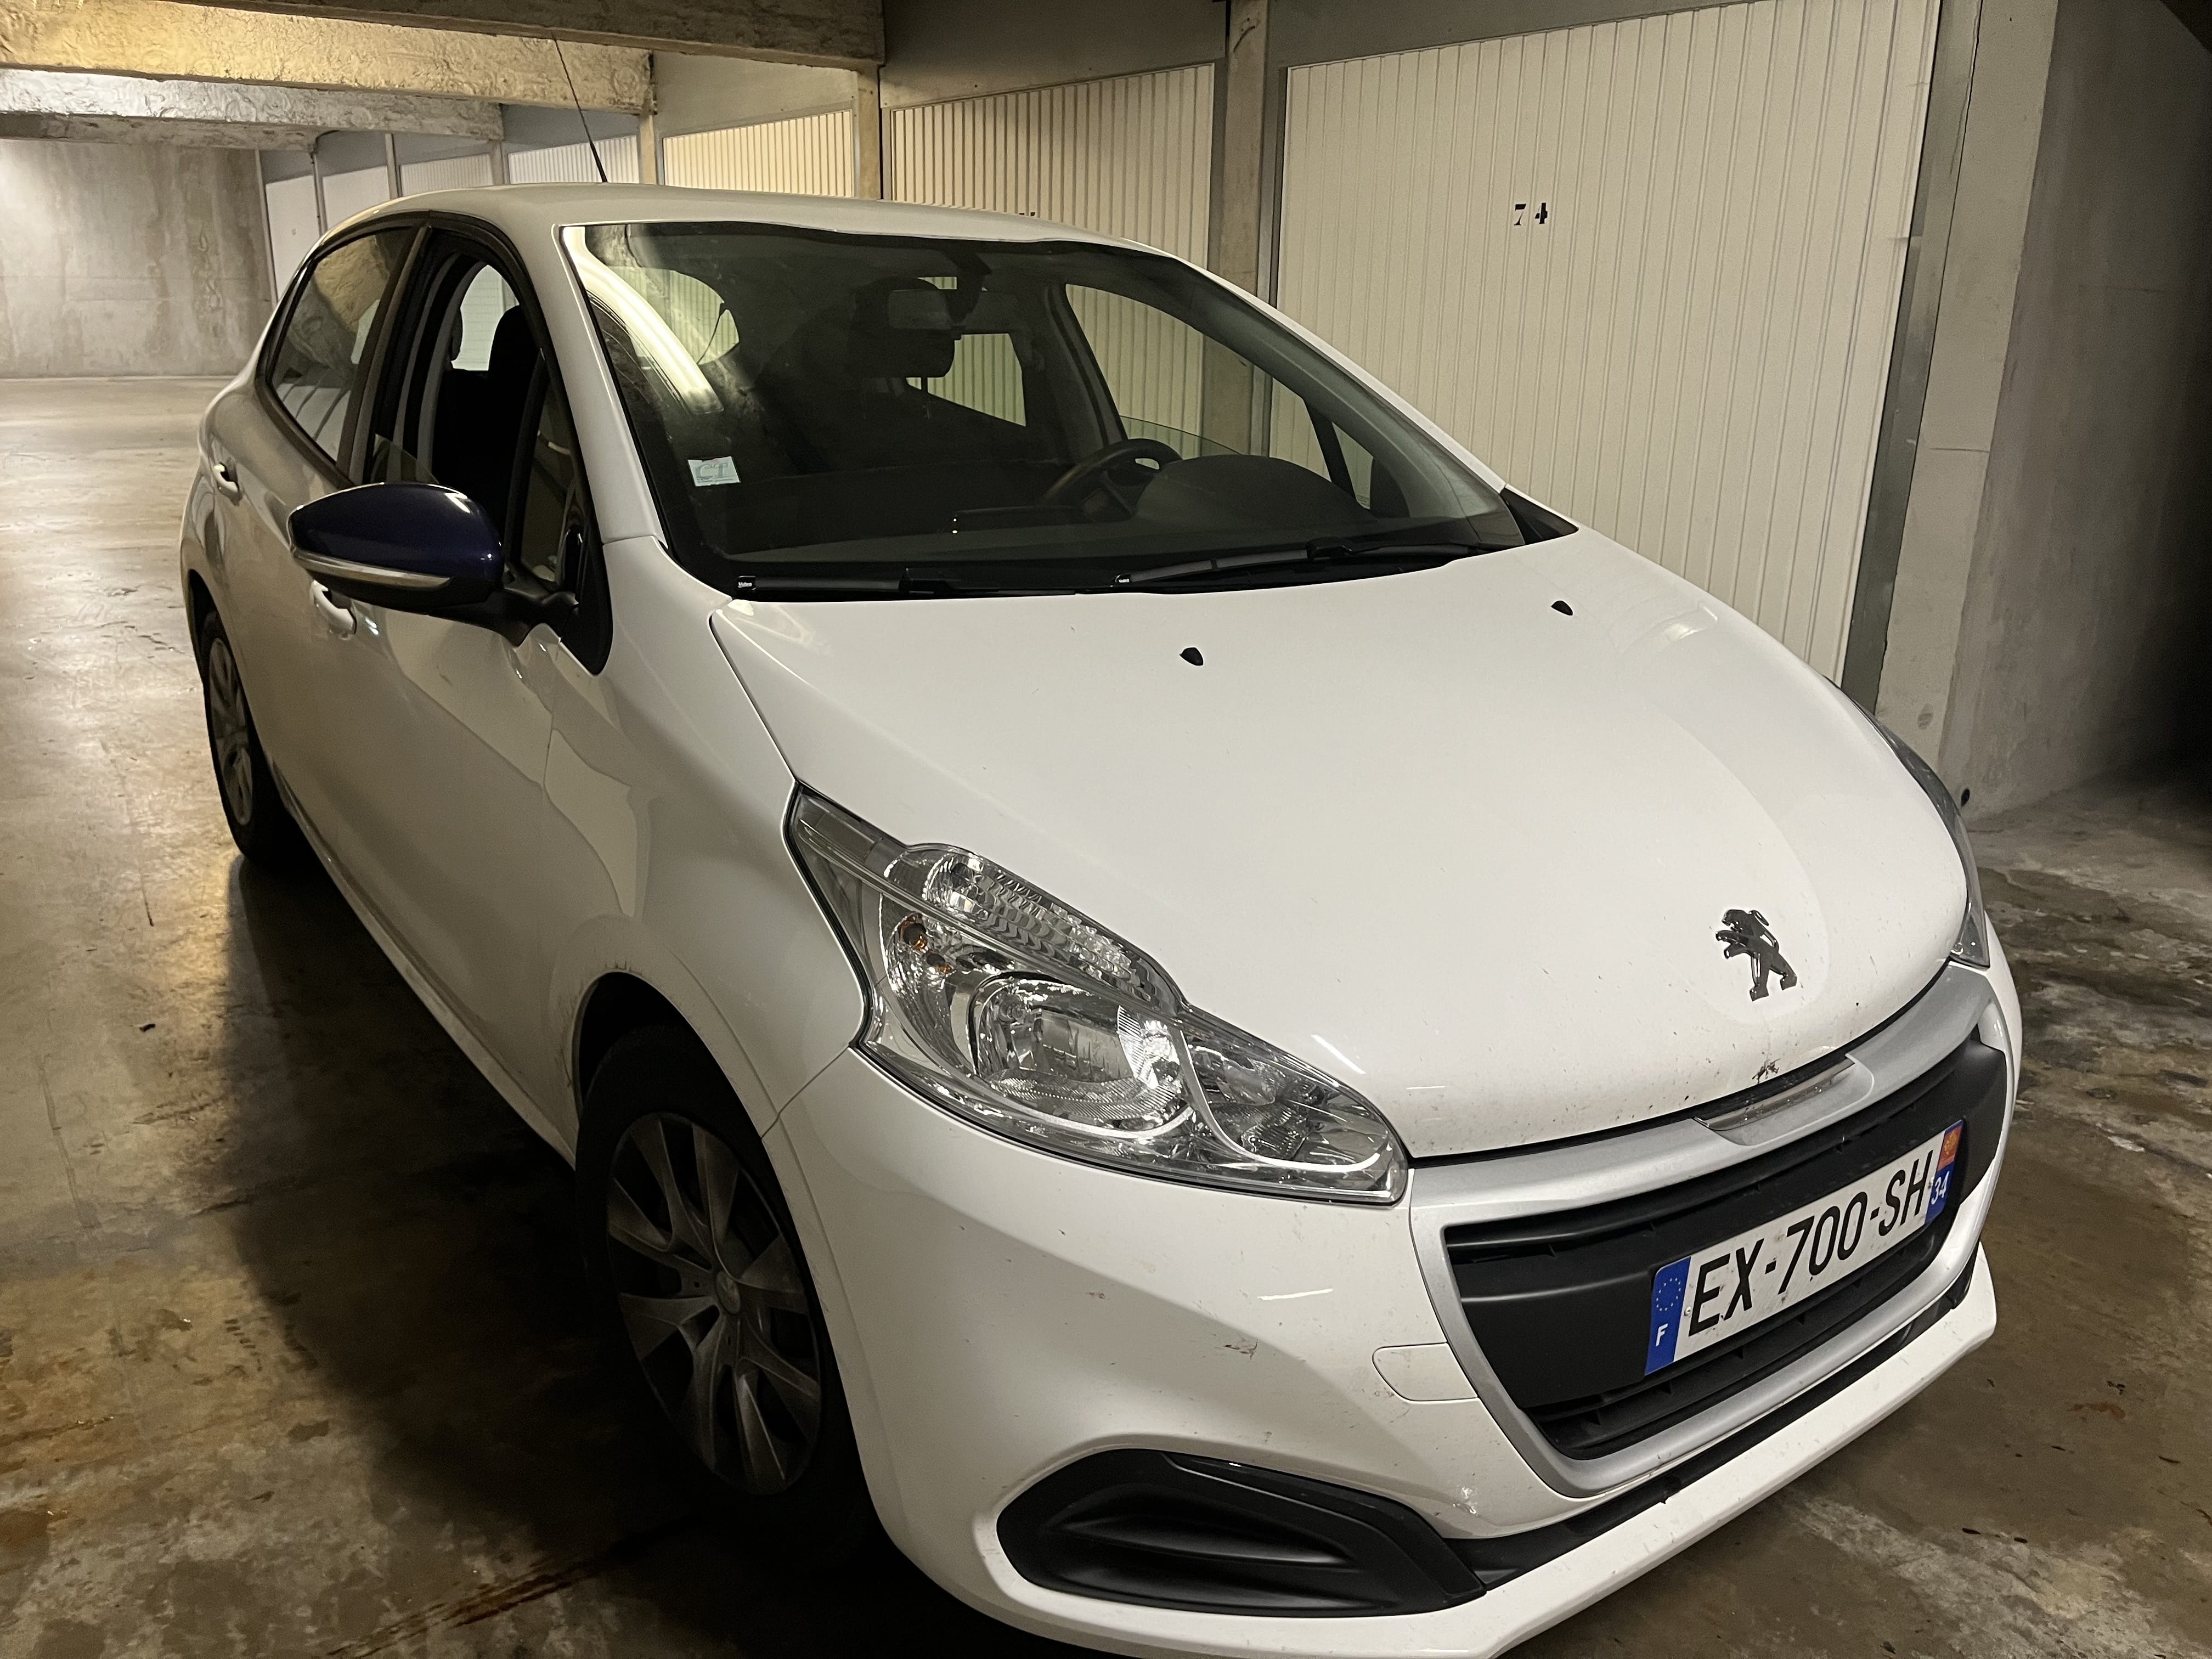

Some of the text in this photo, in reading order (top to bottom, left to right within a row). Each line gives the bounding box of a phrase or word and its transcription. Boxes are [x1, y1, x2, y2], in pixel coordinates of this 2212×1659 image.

[1514, 202, 1548, 225] 74
[1931, 1171, 1950, 1205] 34
[1688, 1150, 1933, 1337] EX-700-SH
[1655, 1323, 1668, 1347] F
